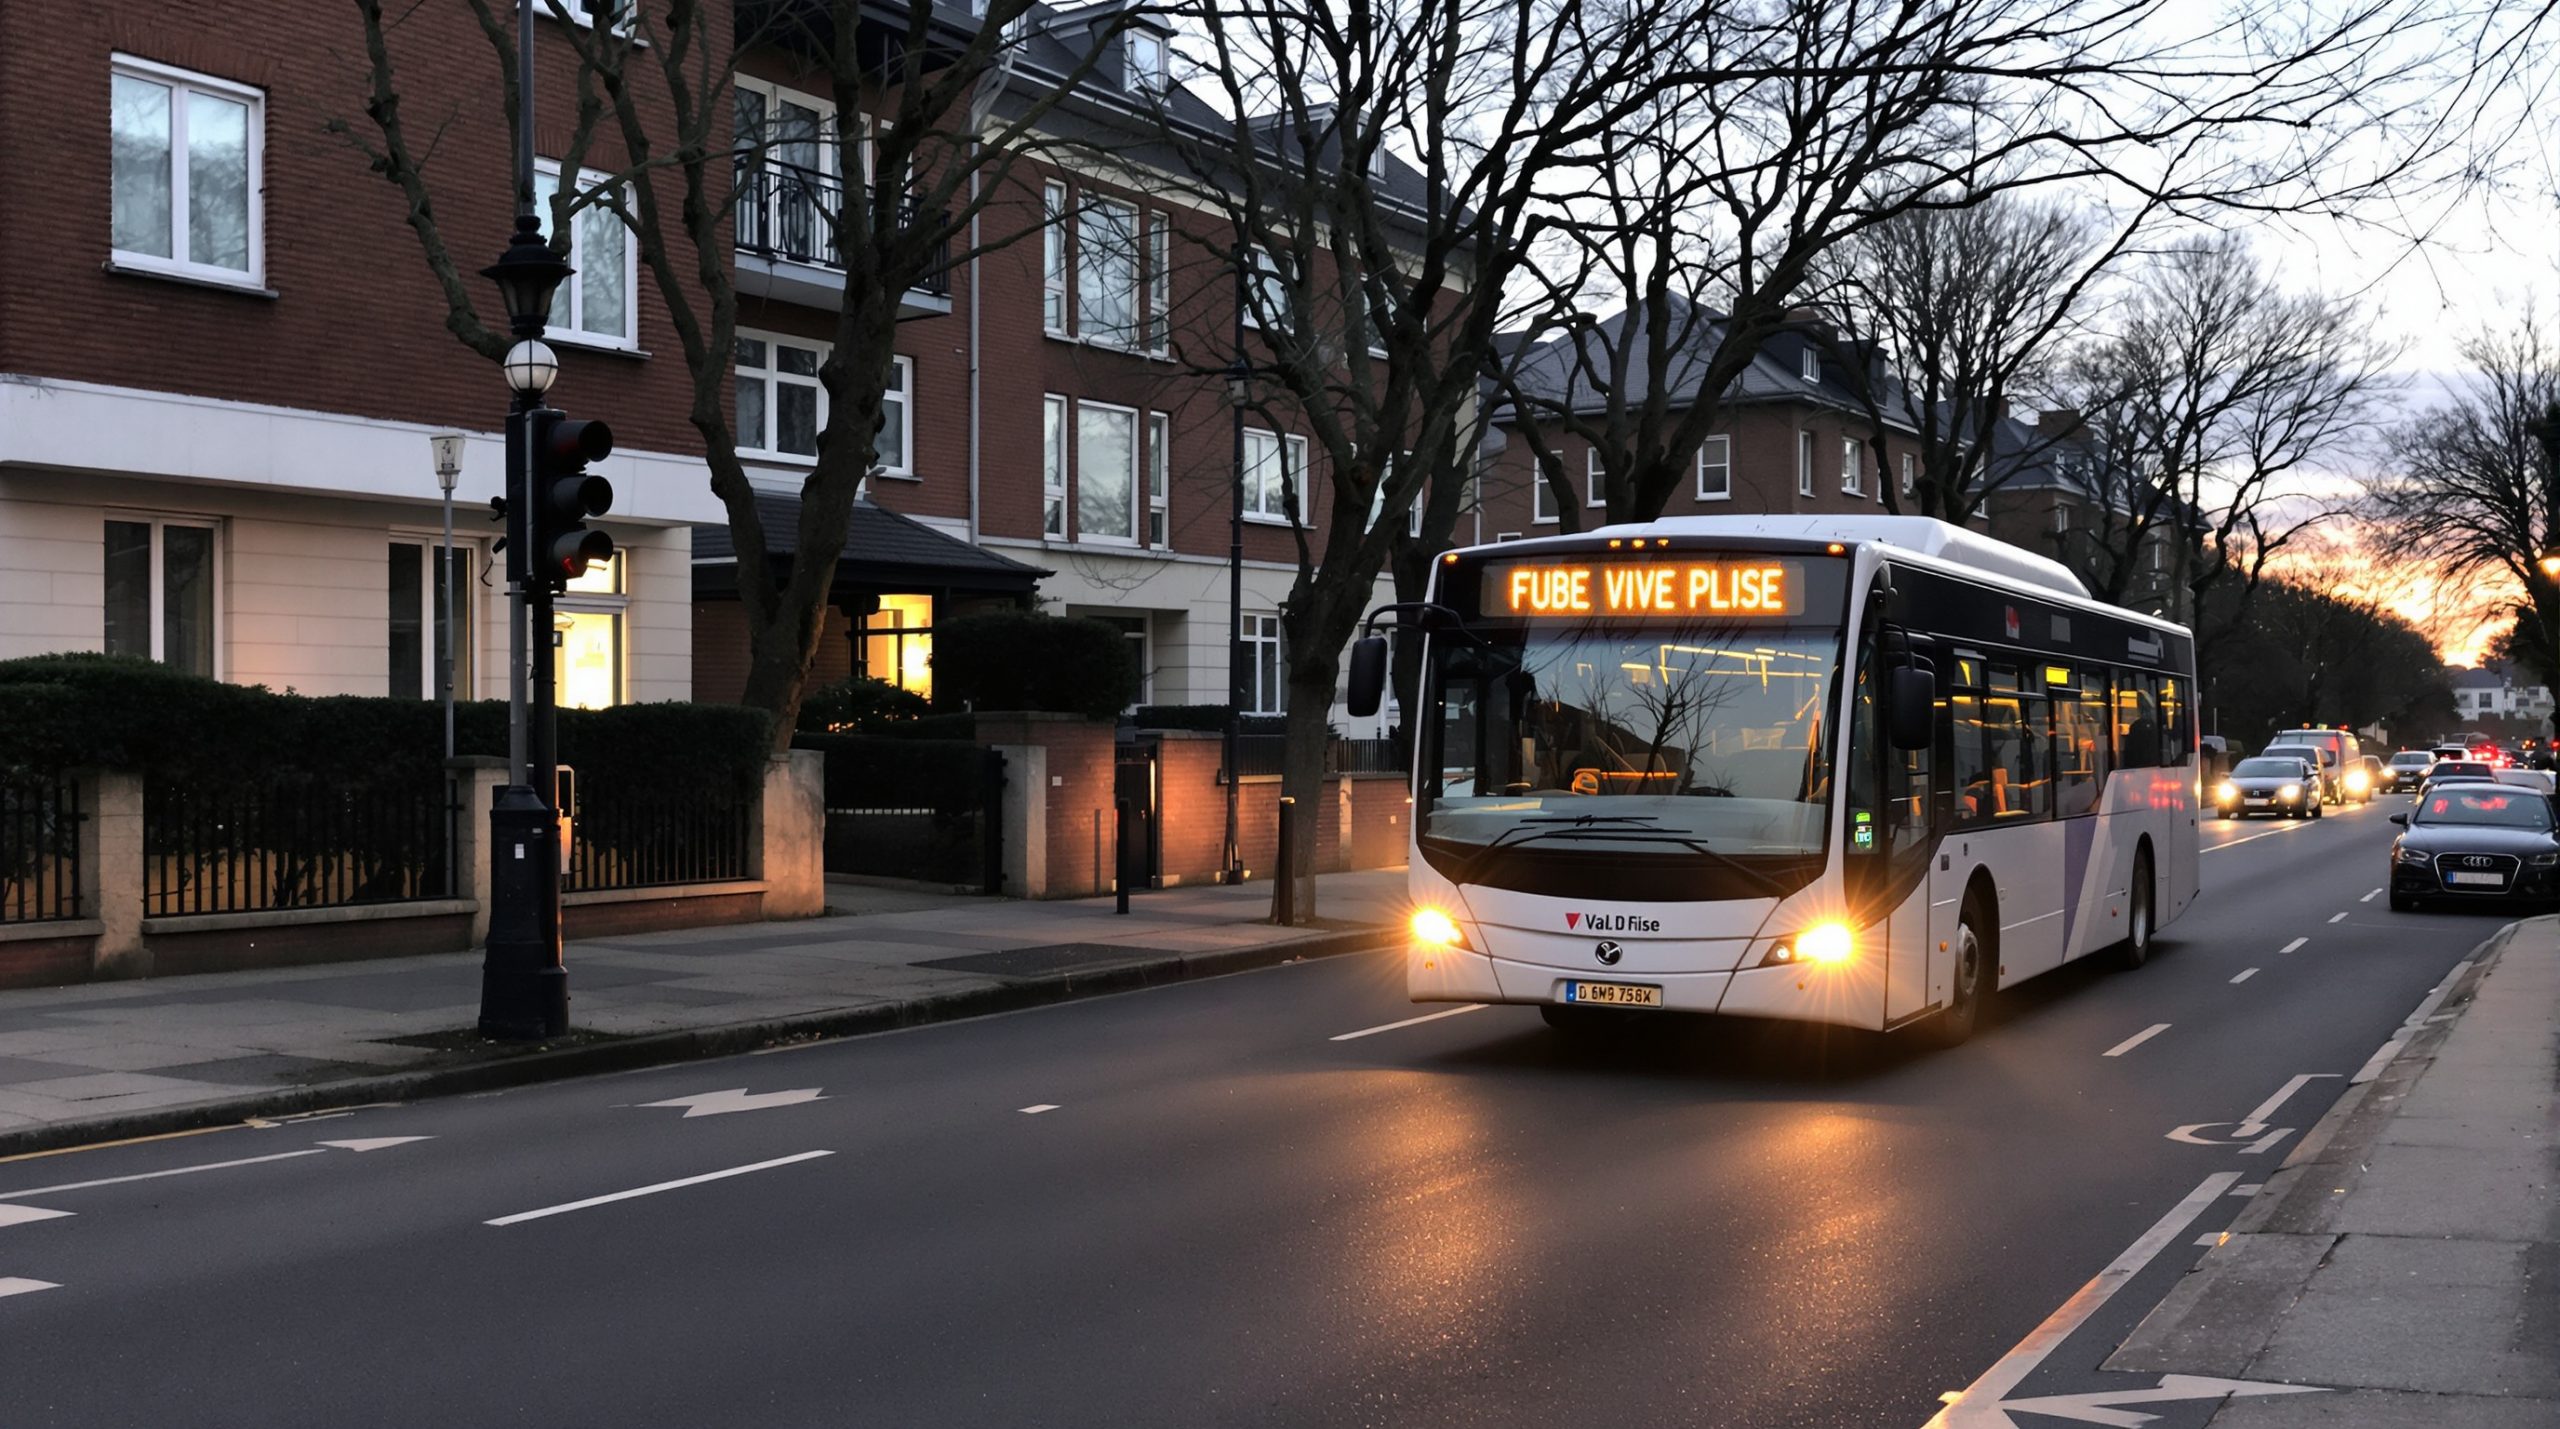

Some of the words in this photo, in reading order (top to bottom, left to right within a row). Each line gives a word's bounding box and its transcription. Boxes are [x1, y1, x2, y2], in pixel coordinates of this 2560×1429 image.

[1510, 570, 1591, 610] FUBE
[1605, 569, 1676, 610] VIVE
[1689, 568, 1784, 609] PLISE
